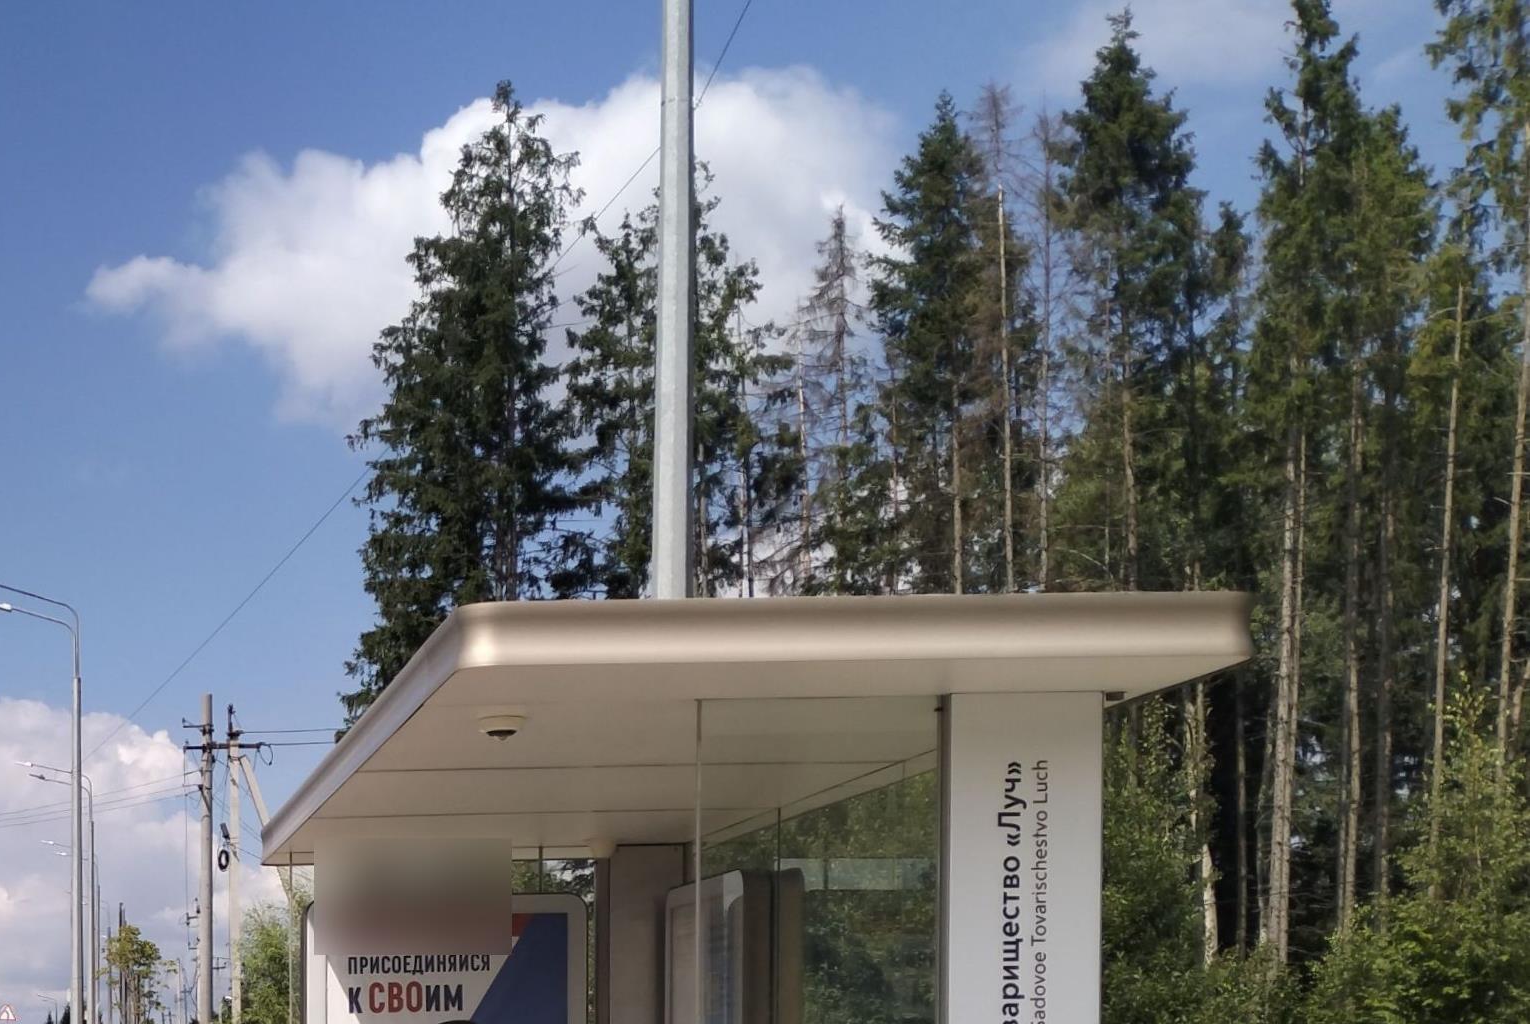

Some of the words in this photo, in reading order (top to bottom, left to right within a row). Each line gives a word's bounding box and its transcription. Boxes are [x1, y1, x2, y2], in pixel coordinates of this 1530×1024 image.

[997, 761, 1027, 847] «Луч»
[1031, 760, 1048, 804] Luch
[1030, 810, 1048, 947] Tovarischestvo
